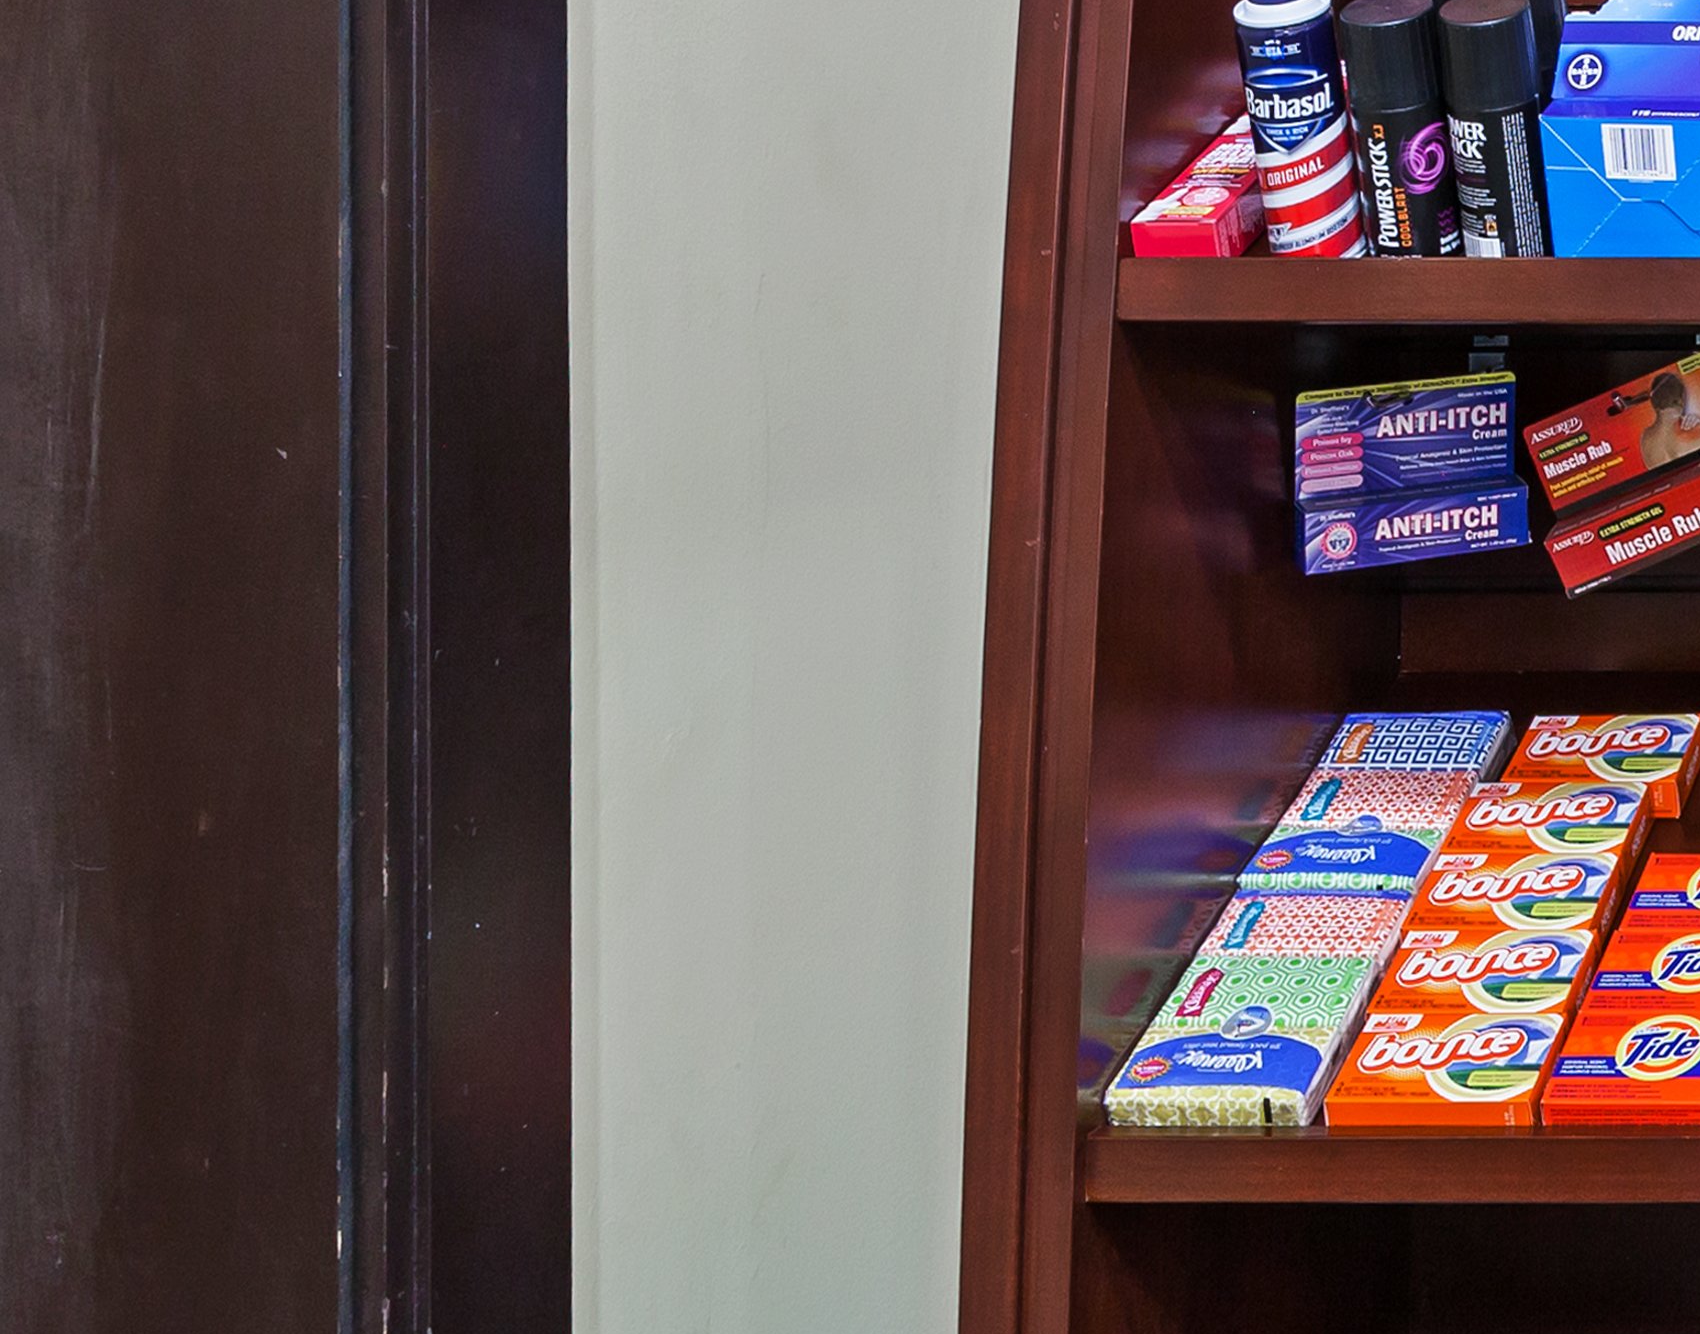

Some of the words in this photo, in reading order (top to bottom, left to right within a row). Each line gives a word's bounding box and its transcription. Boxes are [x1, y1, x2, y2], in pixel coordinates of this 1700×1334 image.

[1246, 82, 1335, 120] Barbasol
[1267, 156, 1325, 188] ORIGINAL
[1375, 505, 1498, 541] ANTI-ITCH
[1465, 530, 1498, 541] Cream
[1553, 530, 1594, 552] ASSURED
[1605, 529, 1673, 565] Muscle
[1361, 1029, 1527, 1073] bounce
[1622, 1029, 1700, 1069] Tide
